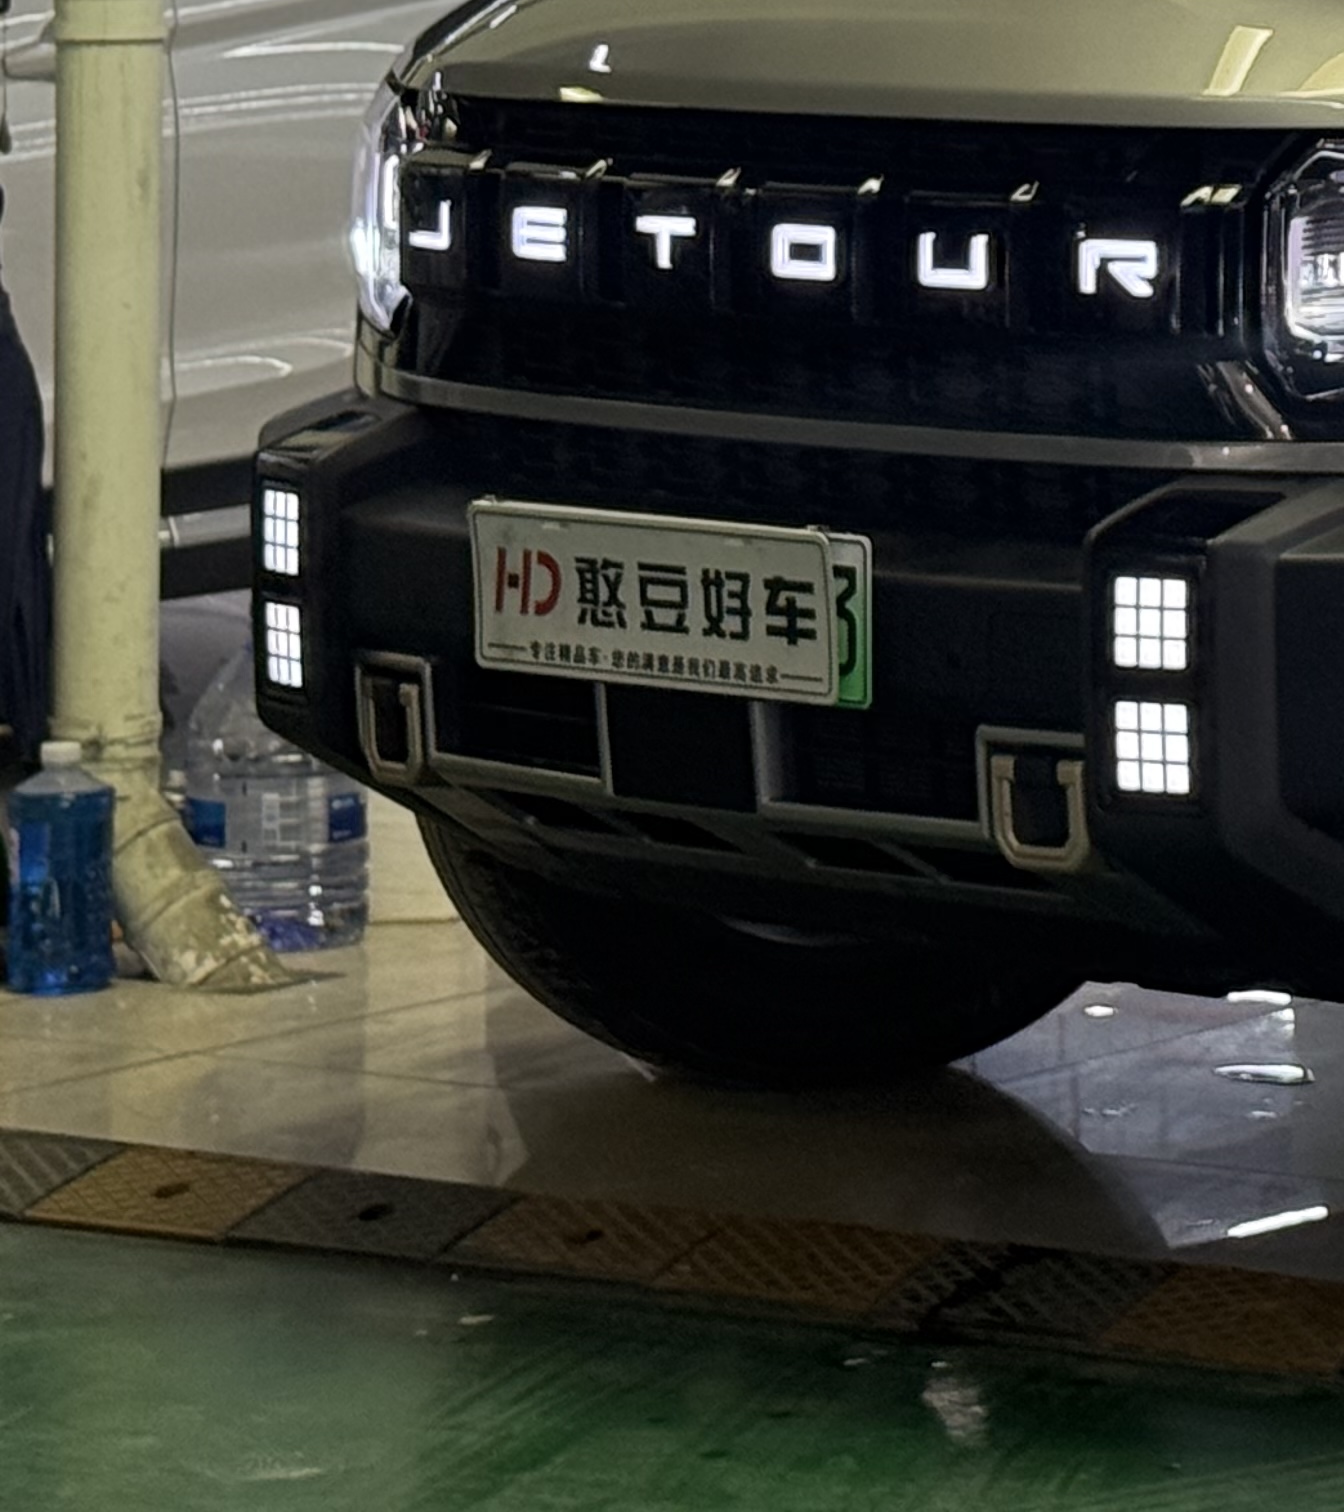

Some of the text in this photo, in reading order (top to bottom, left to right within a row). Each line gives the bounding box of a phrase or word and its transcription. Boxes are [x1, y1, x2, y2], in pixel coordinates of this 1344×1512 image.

[405, 196, 1160, 300] JETOUR
[575, 556, 818, 646] 憨豆好车
